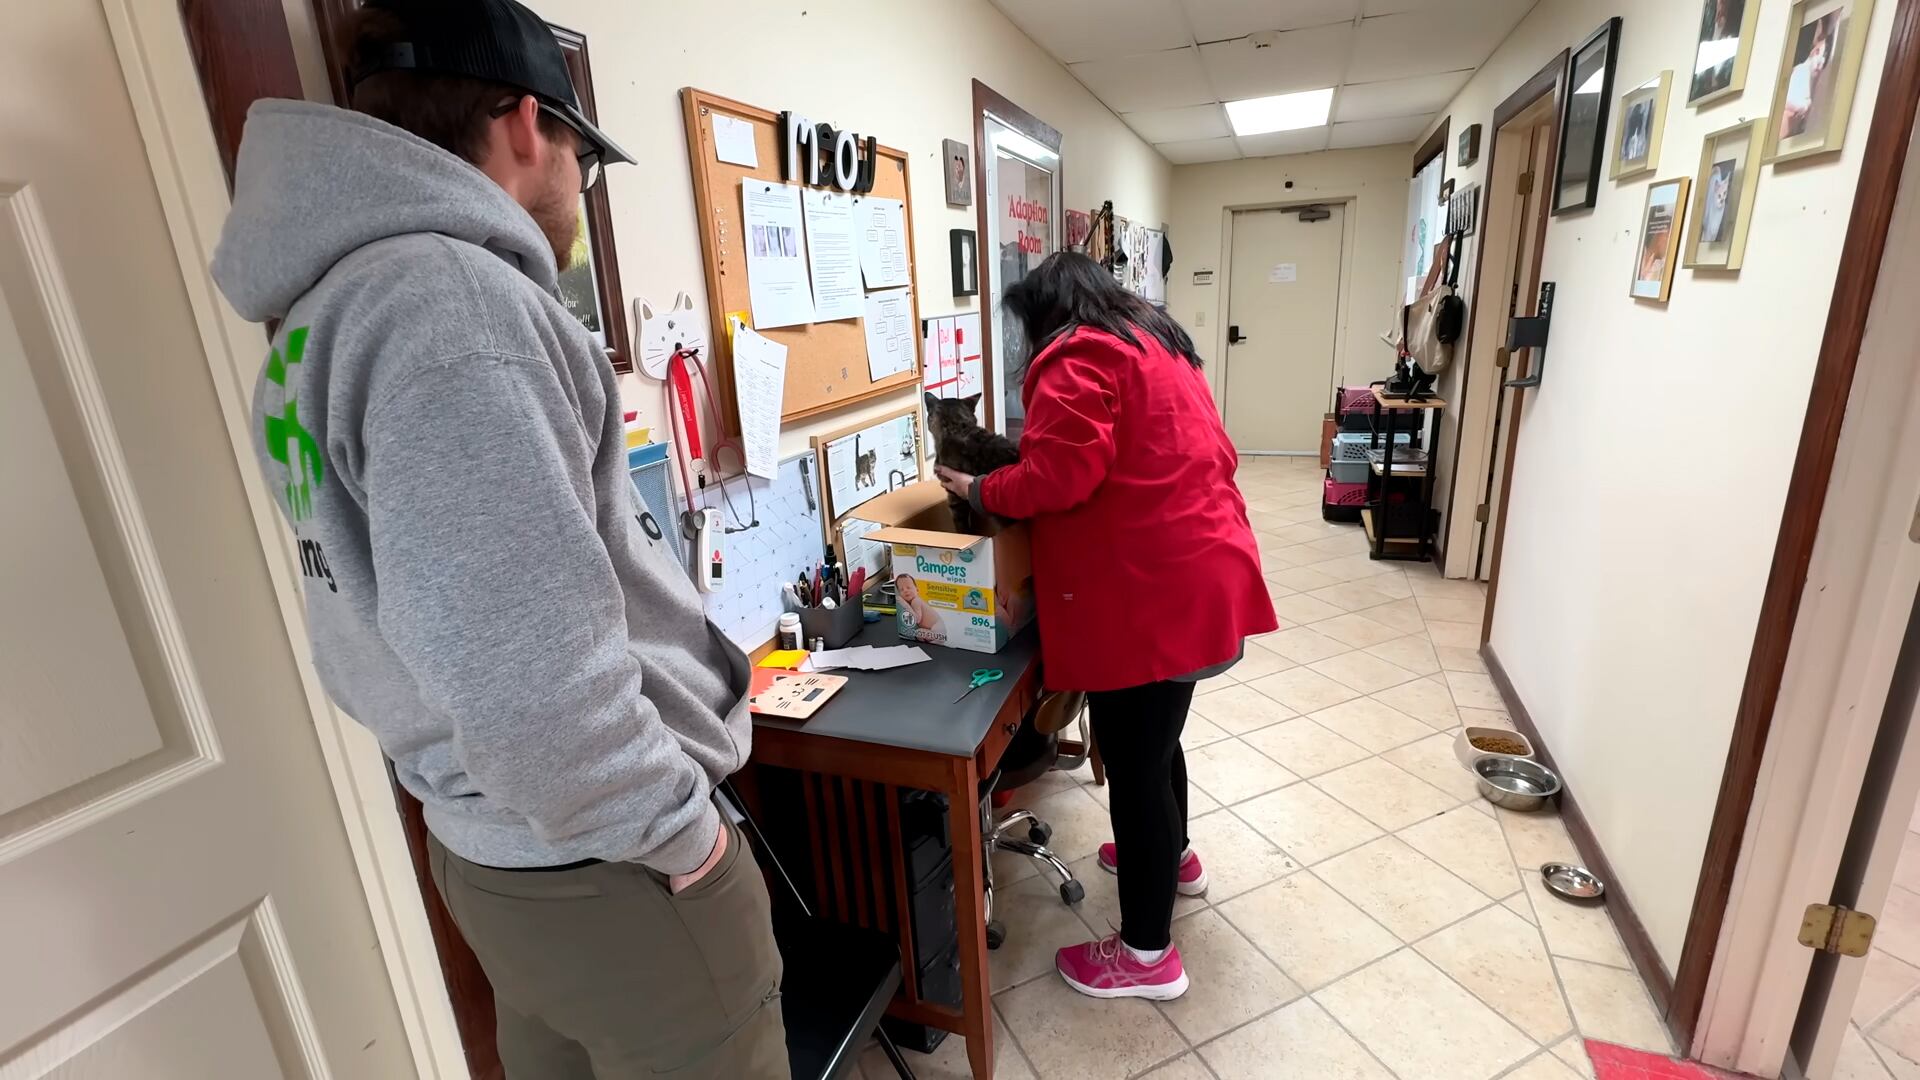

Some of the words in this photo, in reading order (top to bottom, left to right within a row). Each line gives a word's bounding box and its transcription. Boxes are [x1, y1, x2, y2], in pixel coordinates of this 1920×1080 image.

[1008, 195, 1048, 226] Adoption
[1017, 230, 1042, 254] Room
[916, 555, 967, 578] Pampers
[946, 576, 966, 584] wipes
[926, 583, 958, 594] Sensitive
[971, 616, 990, 628] 896
[927, 631, 948, 642] FLUSH
